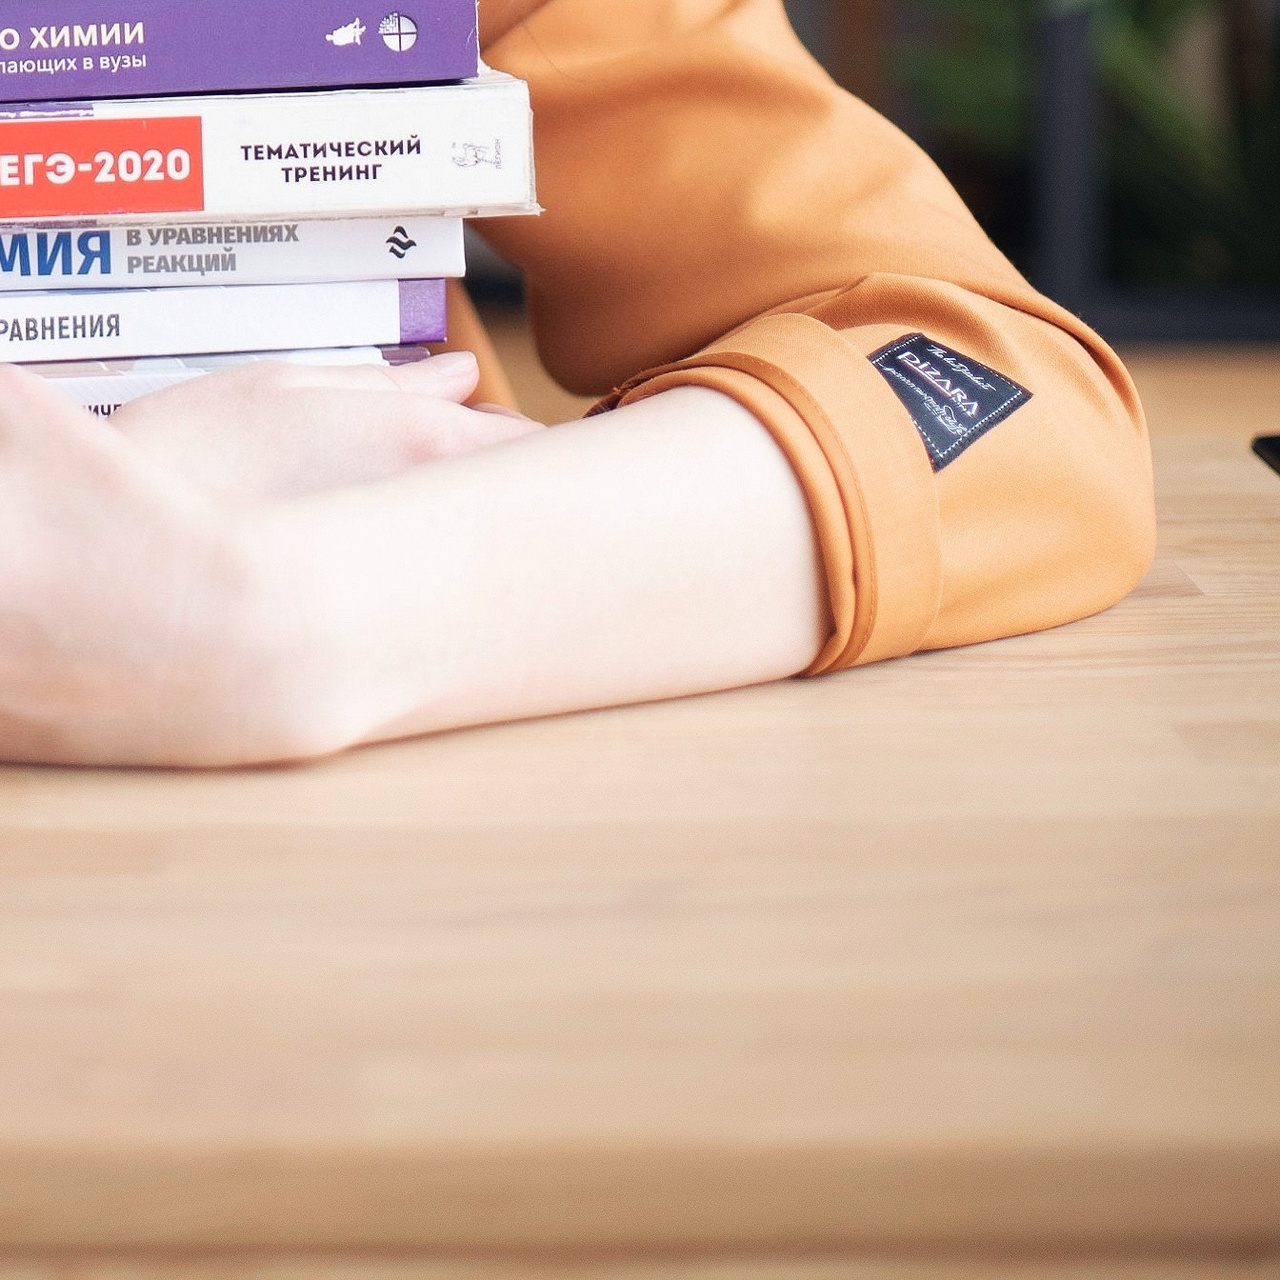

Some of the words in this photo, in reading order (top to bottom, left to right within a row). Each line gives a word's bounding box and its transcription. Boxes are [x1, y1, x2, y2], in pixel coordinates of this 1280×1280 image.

[99, 54, 147, 73] вузы
[240, 135, 422, 162] ТЕМАТИЧЕСКИЙ
[0, 148, 191, 188] ЕГЭ-2020
[281, 163, 383, 184] ТРЕНИНГ
[149, 223, 299, 246] УРАВНЕНИЯХ
[126, 248, 237, 276] РЕАКЦИЙ
